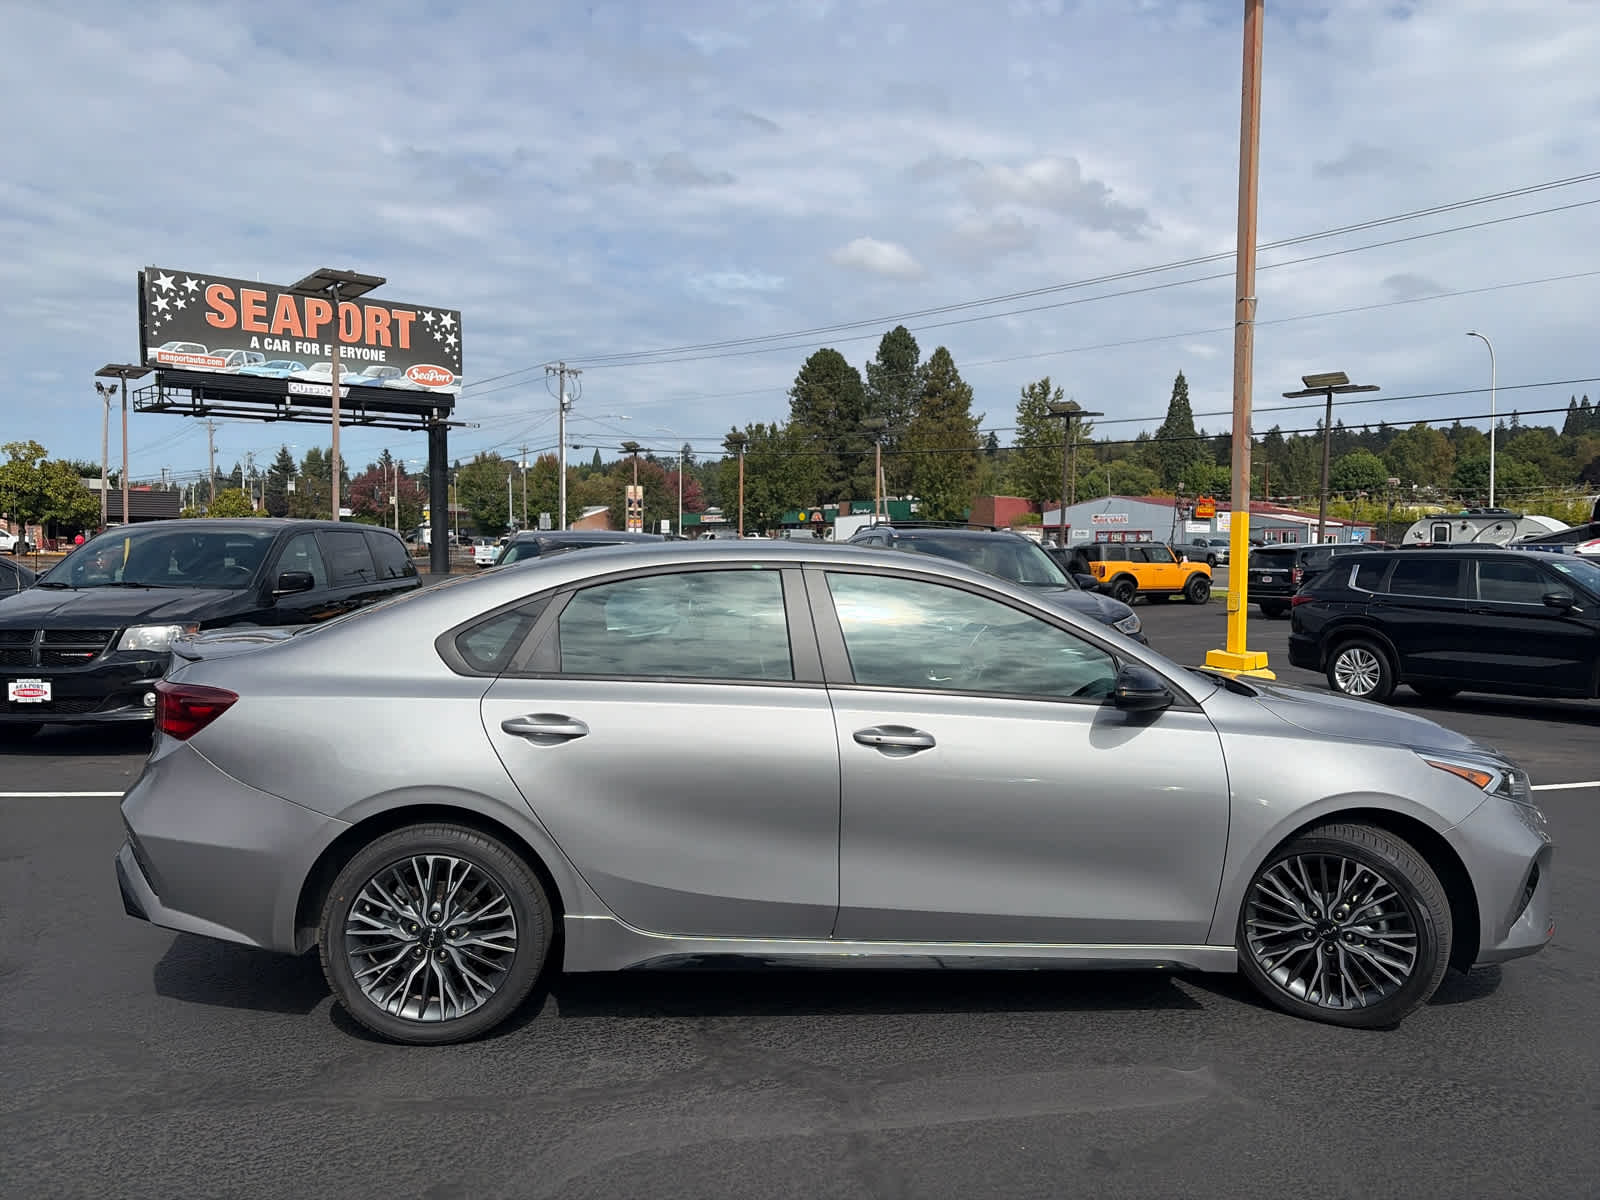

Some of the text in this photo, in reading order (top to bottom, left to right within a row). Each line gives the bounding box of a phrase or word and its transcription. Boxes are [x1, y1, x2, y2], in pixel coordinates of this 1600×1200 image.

[205, 284, 417, 349] SEAPORT
[160, 353, 223, 367] seaportauto.com
[250, 336, 386, 362] A CAR FOR EERYONE
